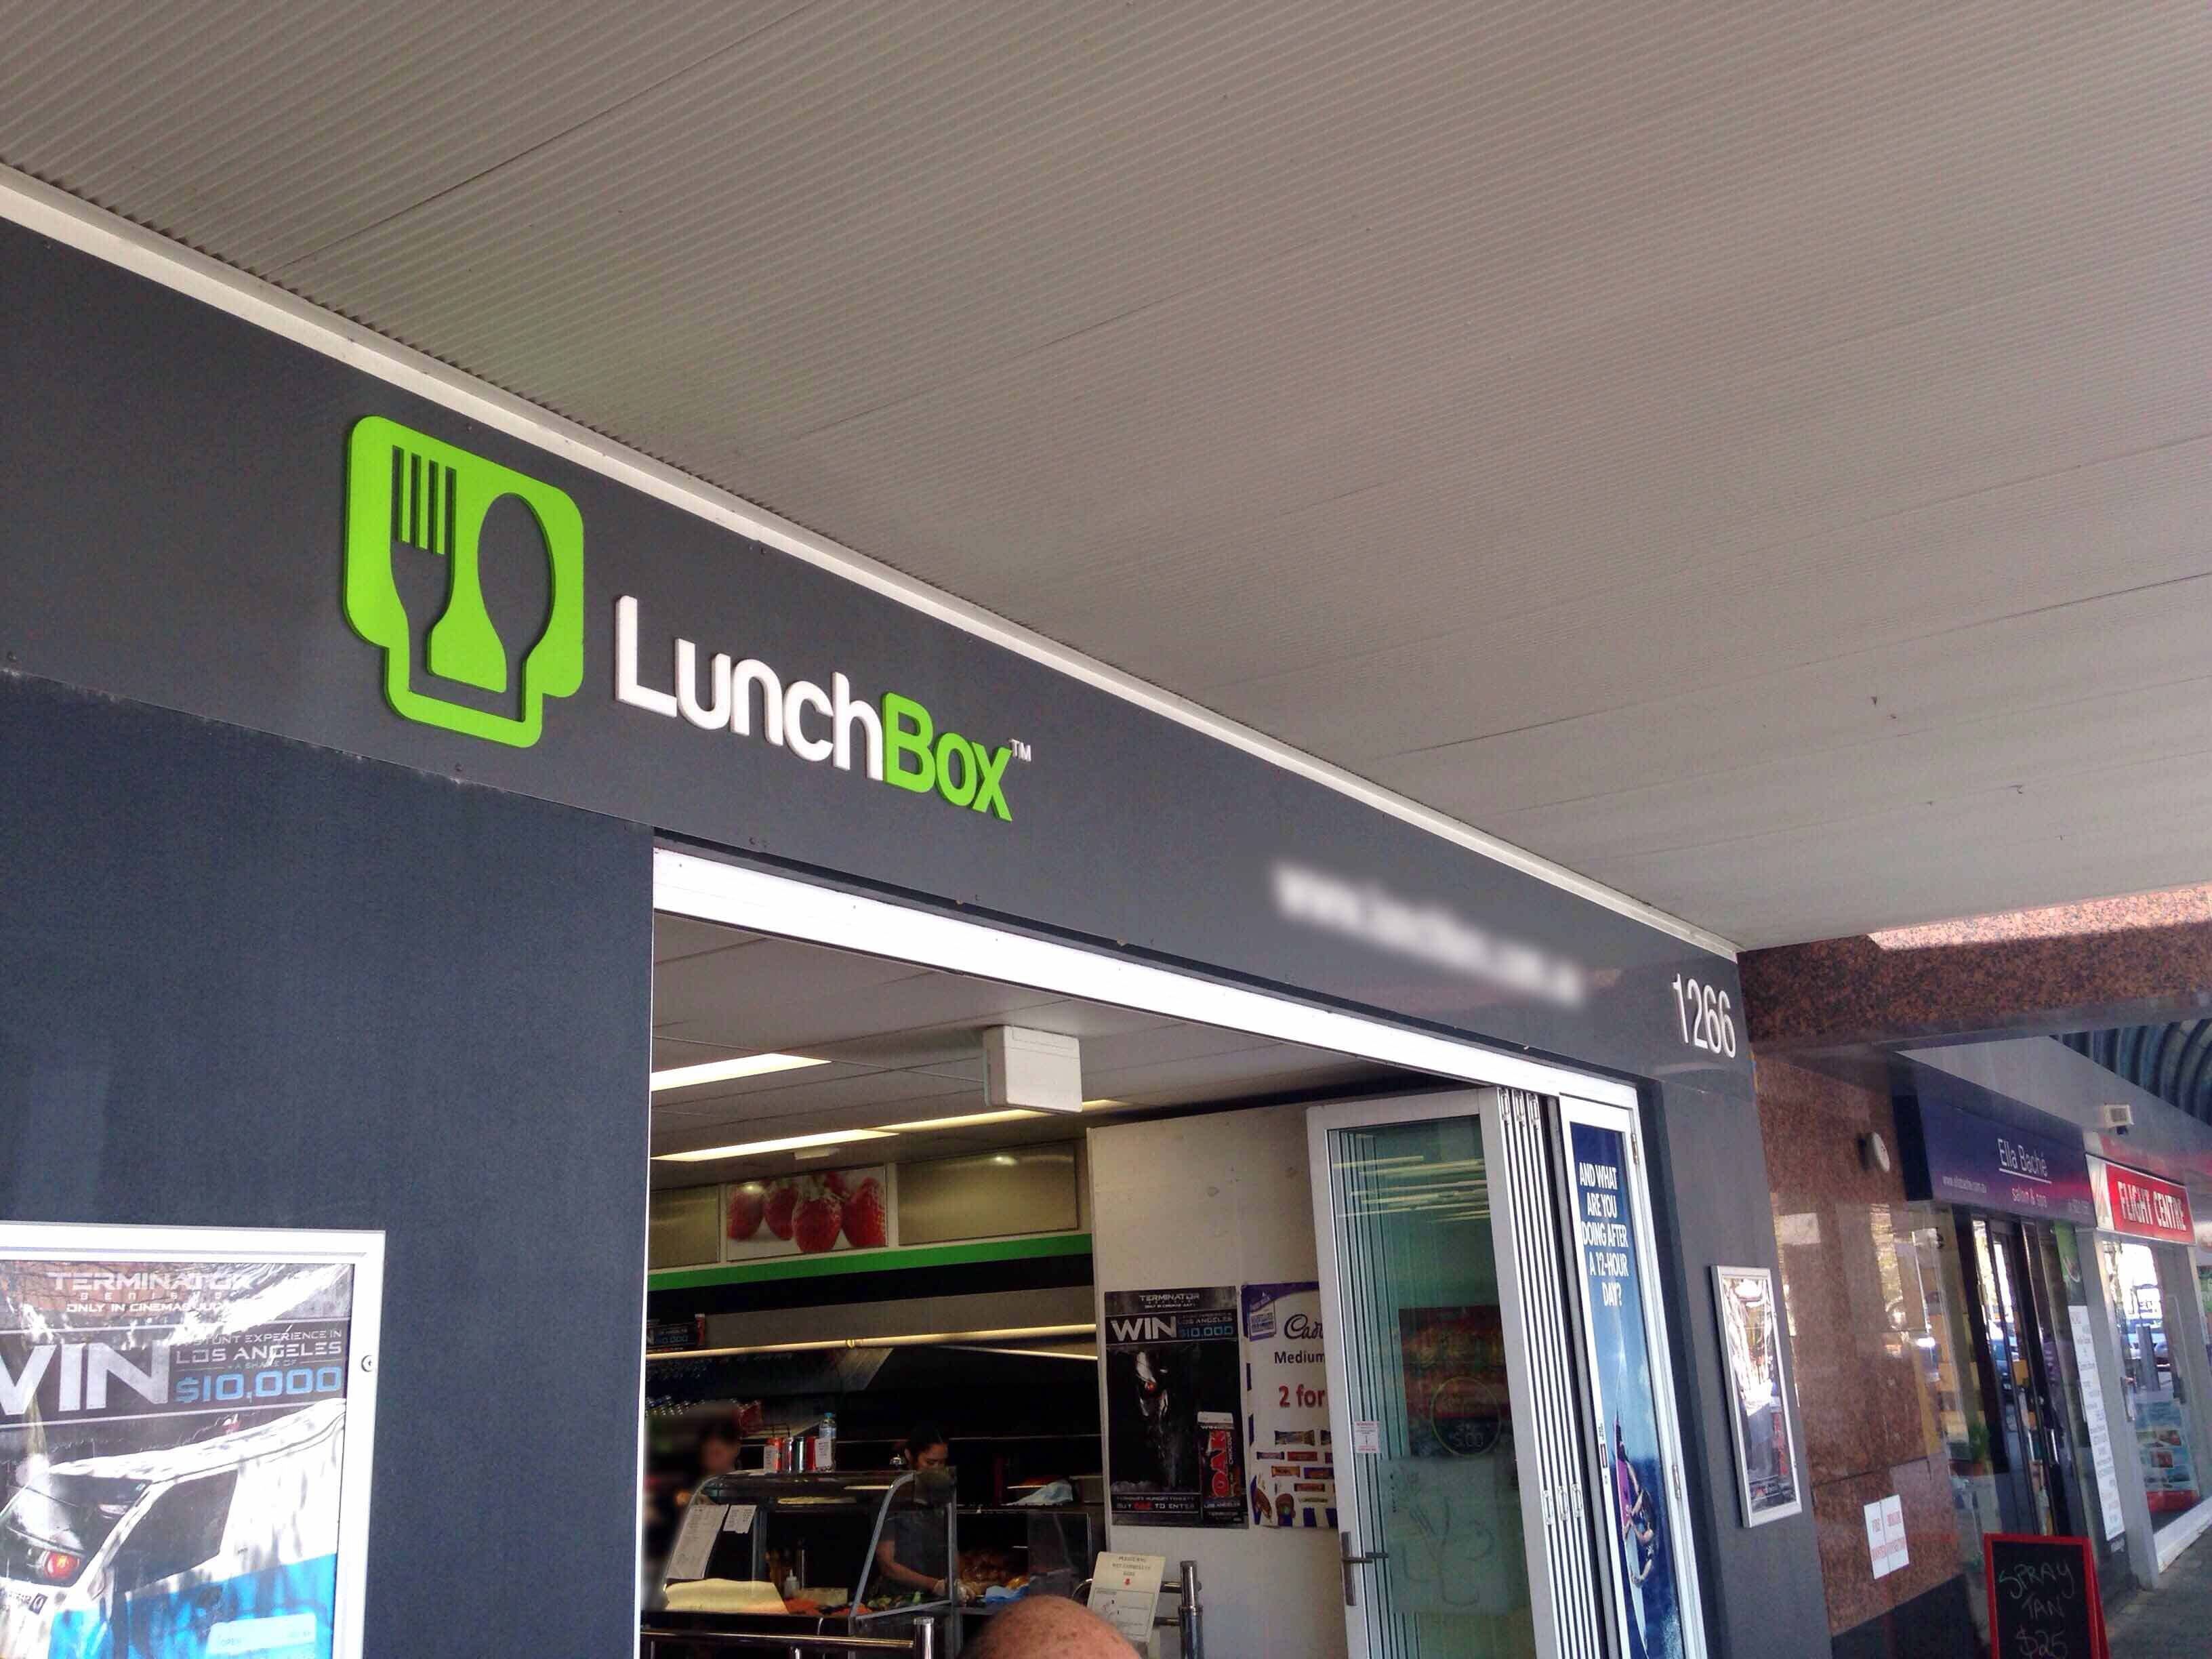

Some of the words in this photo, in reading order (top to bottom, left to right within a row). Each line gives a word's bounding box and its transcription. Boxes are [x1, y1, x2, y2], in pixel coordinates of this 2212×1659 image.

[615, 595, 1012, 822] LunchBox
[1672, 973, 1736, 1058] 1266
[1998, 1139, 2018, 1169] Ella
[1580, 1162, 1595, 1187] AND
[1595, 1164, 1618, 1190] WHAT
[1586, 1192, 1601, 1217] ARE
[1601, 1195, 1618, 1218] YOU
[2117, 1181, 2153, 1225] FLIGHT
[2153, 1191, 2186, 1231] CENTRE
[1582, 1221, 1607, 1247] DOING
[1607, 1223, 1629, 1248] AFTER
[1589, 1252, 1596, 1275] A
[1596, 1252, 1629, 1277] 12-HOUR
[46, 1271, 253, 1291] TERMINATOR
[1601, 1282, 1622, 1307] DAY?
[66, 1303, 104, 1313] ONLY
[111, 1303, 125, 1312] IN
[1139, 1293, 1200, 1302] TERMINATOR
[245, 1330, 326, 1343] EXPERIENCE
[330, 1330, 342, 1338] IN
[1110, 1315, 1177, 1342] WIN
[176, 1348, 227, 1364] LOS
[233, 1341, 342, 1361] ANGELES
[176, 1366, 343, 1403] $10,000
[1279, 1385, 1290, 1408] 2
[1296, 1383, 1326, 1408] for
[1999, 1559, 2075, 1599] SPRAY
[2022, 1593, 2065, 1620] TAN
[2015, 1624, 2068, 1659] $25
